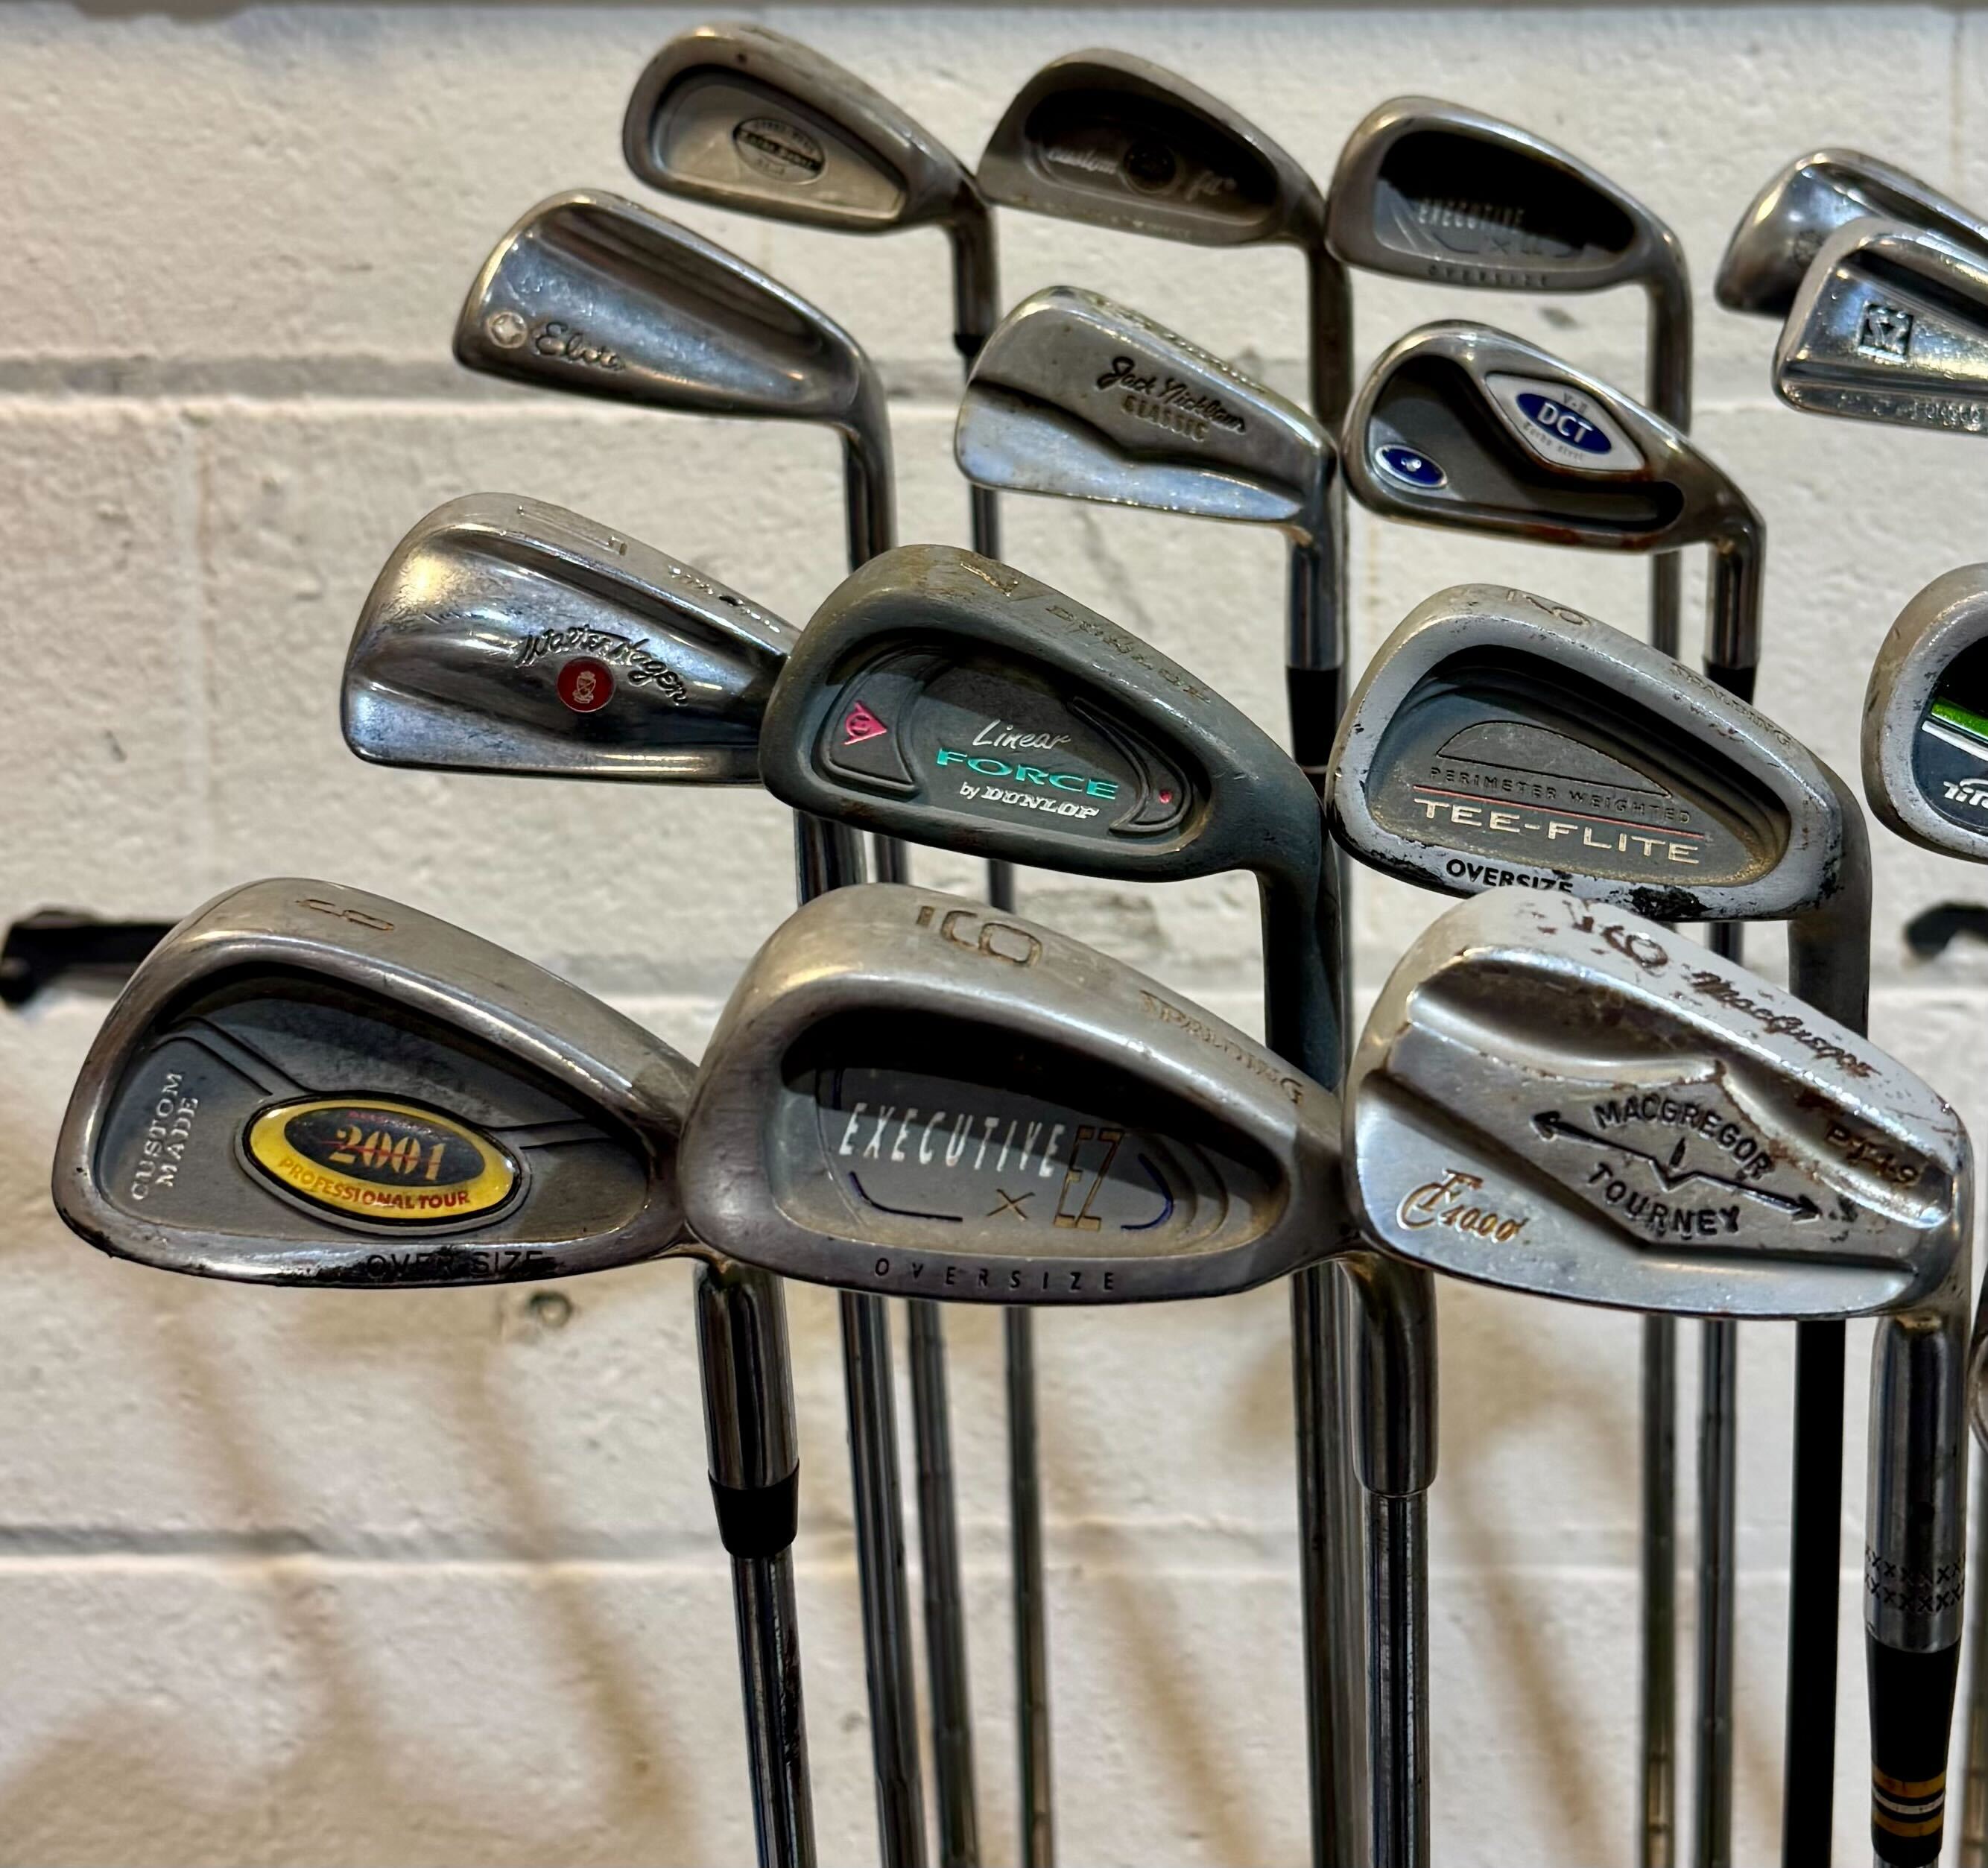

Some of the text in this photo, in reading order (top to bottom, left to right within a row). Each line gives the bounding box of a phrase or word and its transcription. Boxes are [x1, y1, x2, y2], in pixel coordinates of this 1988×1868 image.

[1096, 356, 1156, 395] Jack
[1121, 395, 1209, 442] CLASSIC
[1537, 402, 1595, 443] DCT
[972, 719, 1071, 750] Linear
[937, 747, 1119, 801] FORCE
[959, 781, 1101, 820] by DUNLOP
[1429, 767, 1691, 825] PERIMETER WEIGHTED
[1414, 797, 1700, 865] TEE-FLITE
[1446, 858, 1574, 893] OVERSIZE
[130, 1072, 183, 1201] CUSTOM
[154, 1097, 200, 1188] MADE
[328, 1124, 448, 1182] 2001
[1592, 1092, 1776, 1182] MACGREGOR
[278, 1156, 472, 1210] PROFESSIONAL TOUR
[838, 1102, 1125, 1232] EXECUTIVE EZ
[1586, 1162, 1740, 1240] TOURNEY
[874, 1257, 1115, 1291] OVERSIZE
